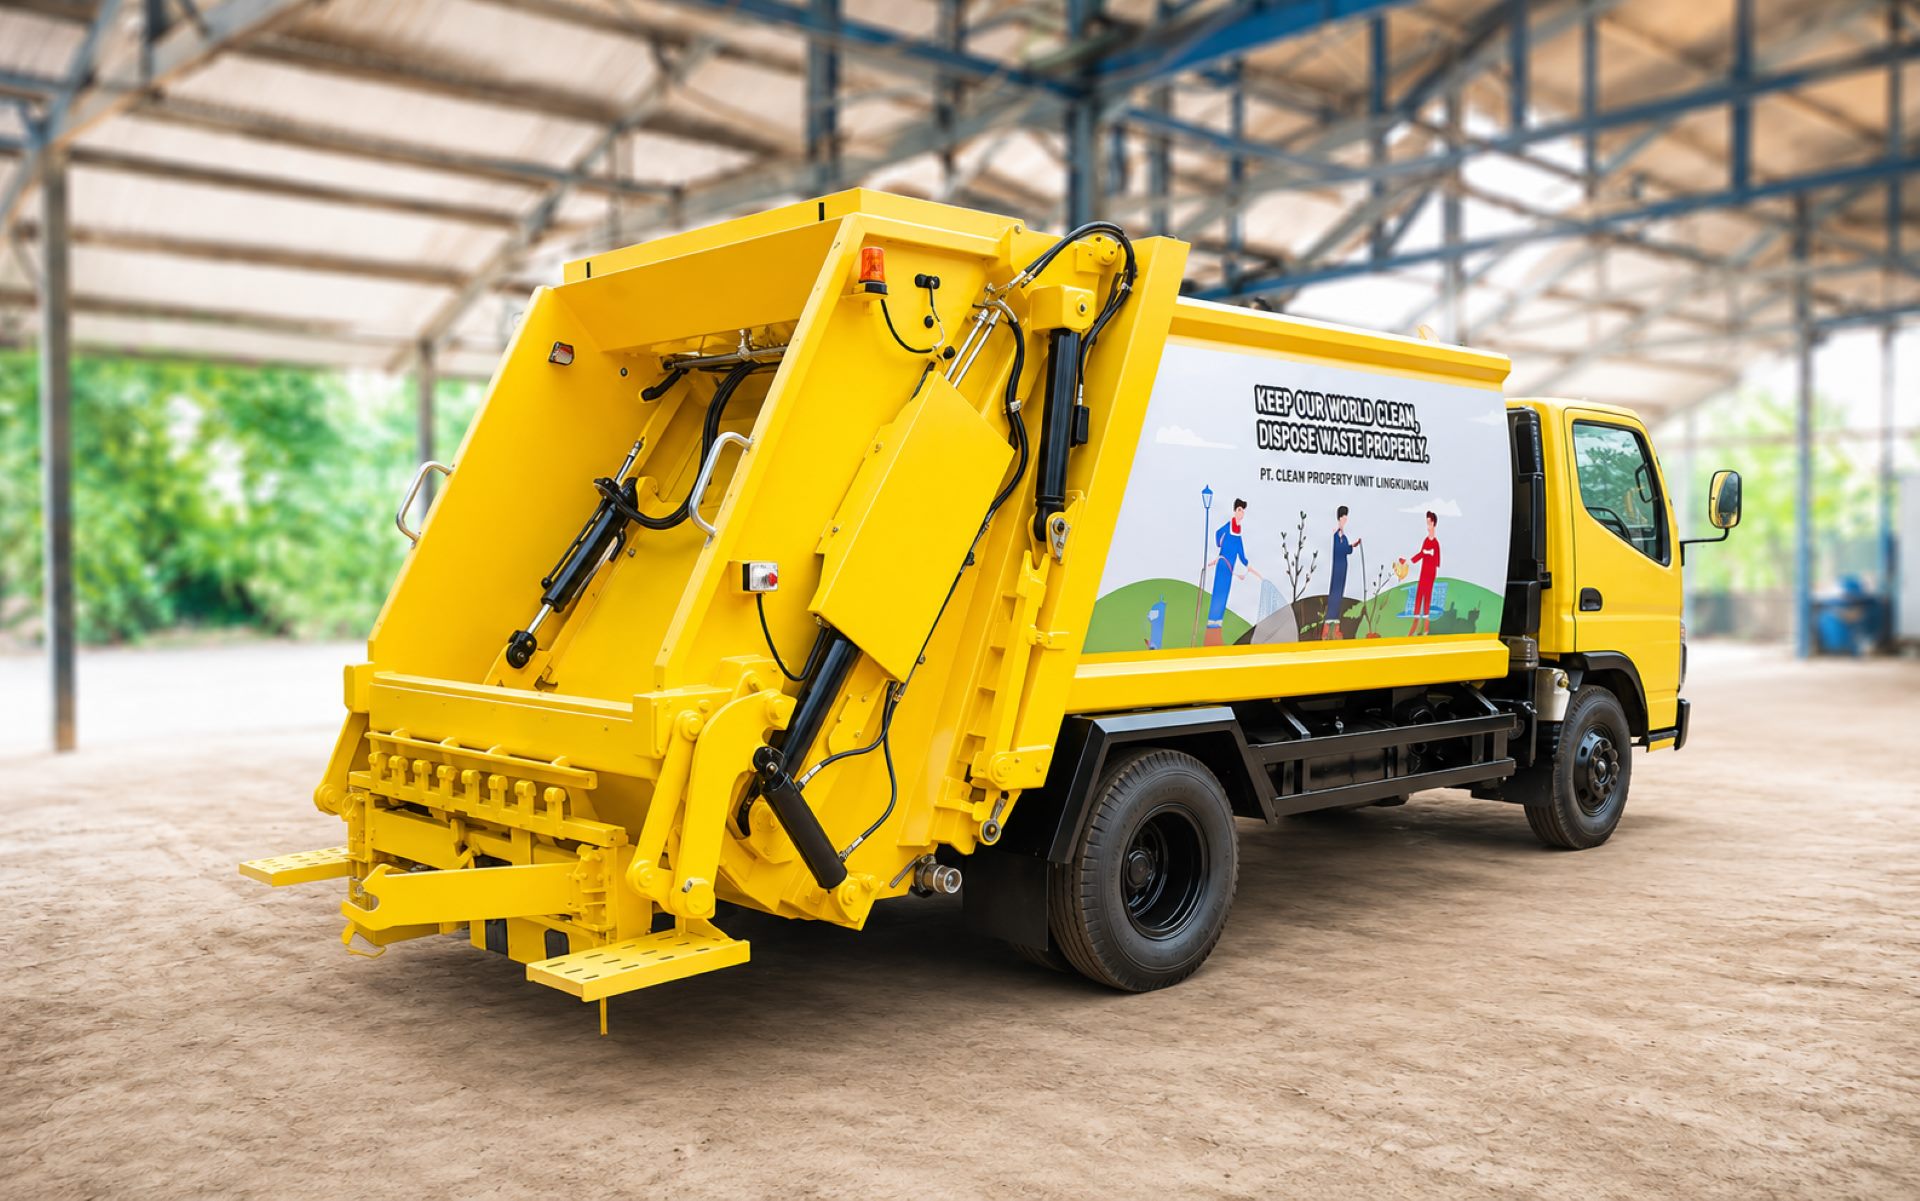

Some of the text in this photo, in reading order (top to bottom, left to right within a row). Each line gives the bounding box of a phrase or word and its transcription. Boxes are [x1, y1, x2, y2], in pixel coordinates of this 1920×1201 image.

[1255, 385, 1421, 433] KEEP OUR WORLD CLEAN,
[1257, 419, 1430, 464] DISPOSE WASTE PROPERLY.
[1260, 468, 1429, 491] PT. CLEAN PROPERTY UNIT LINGKUNGAN
